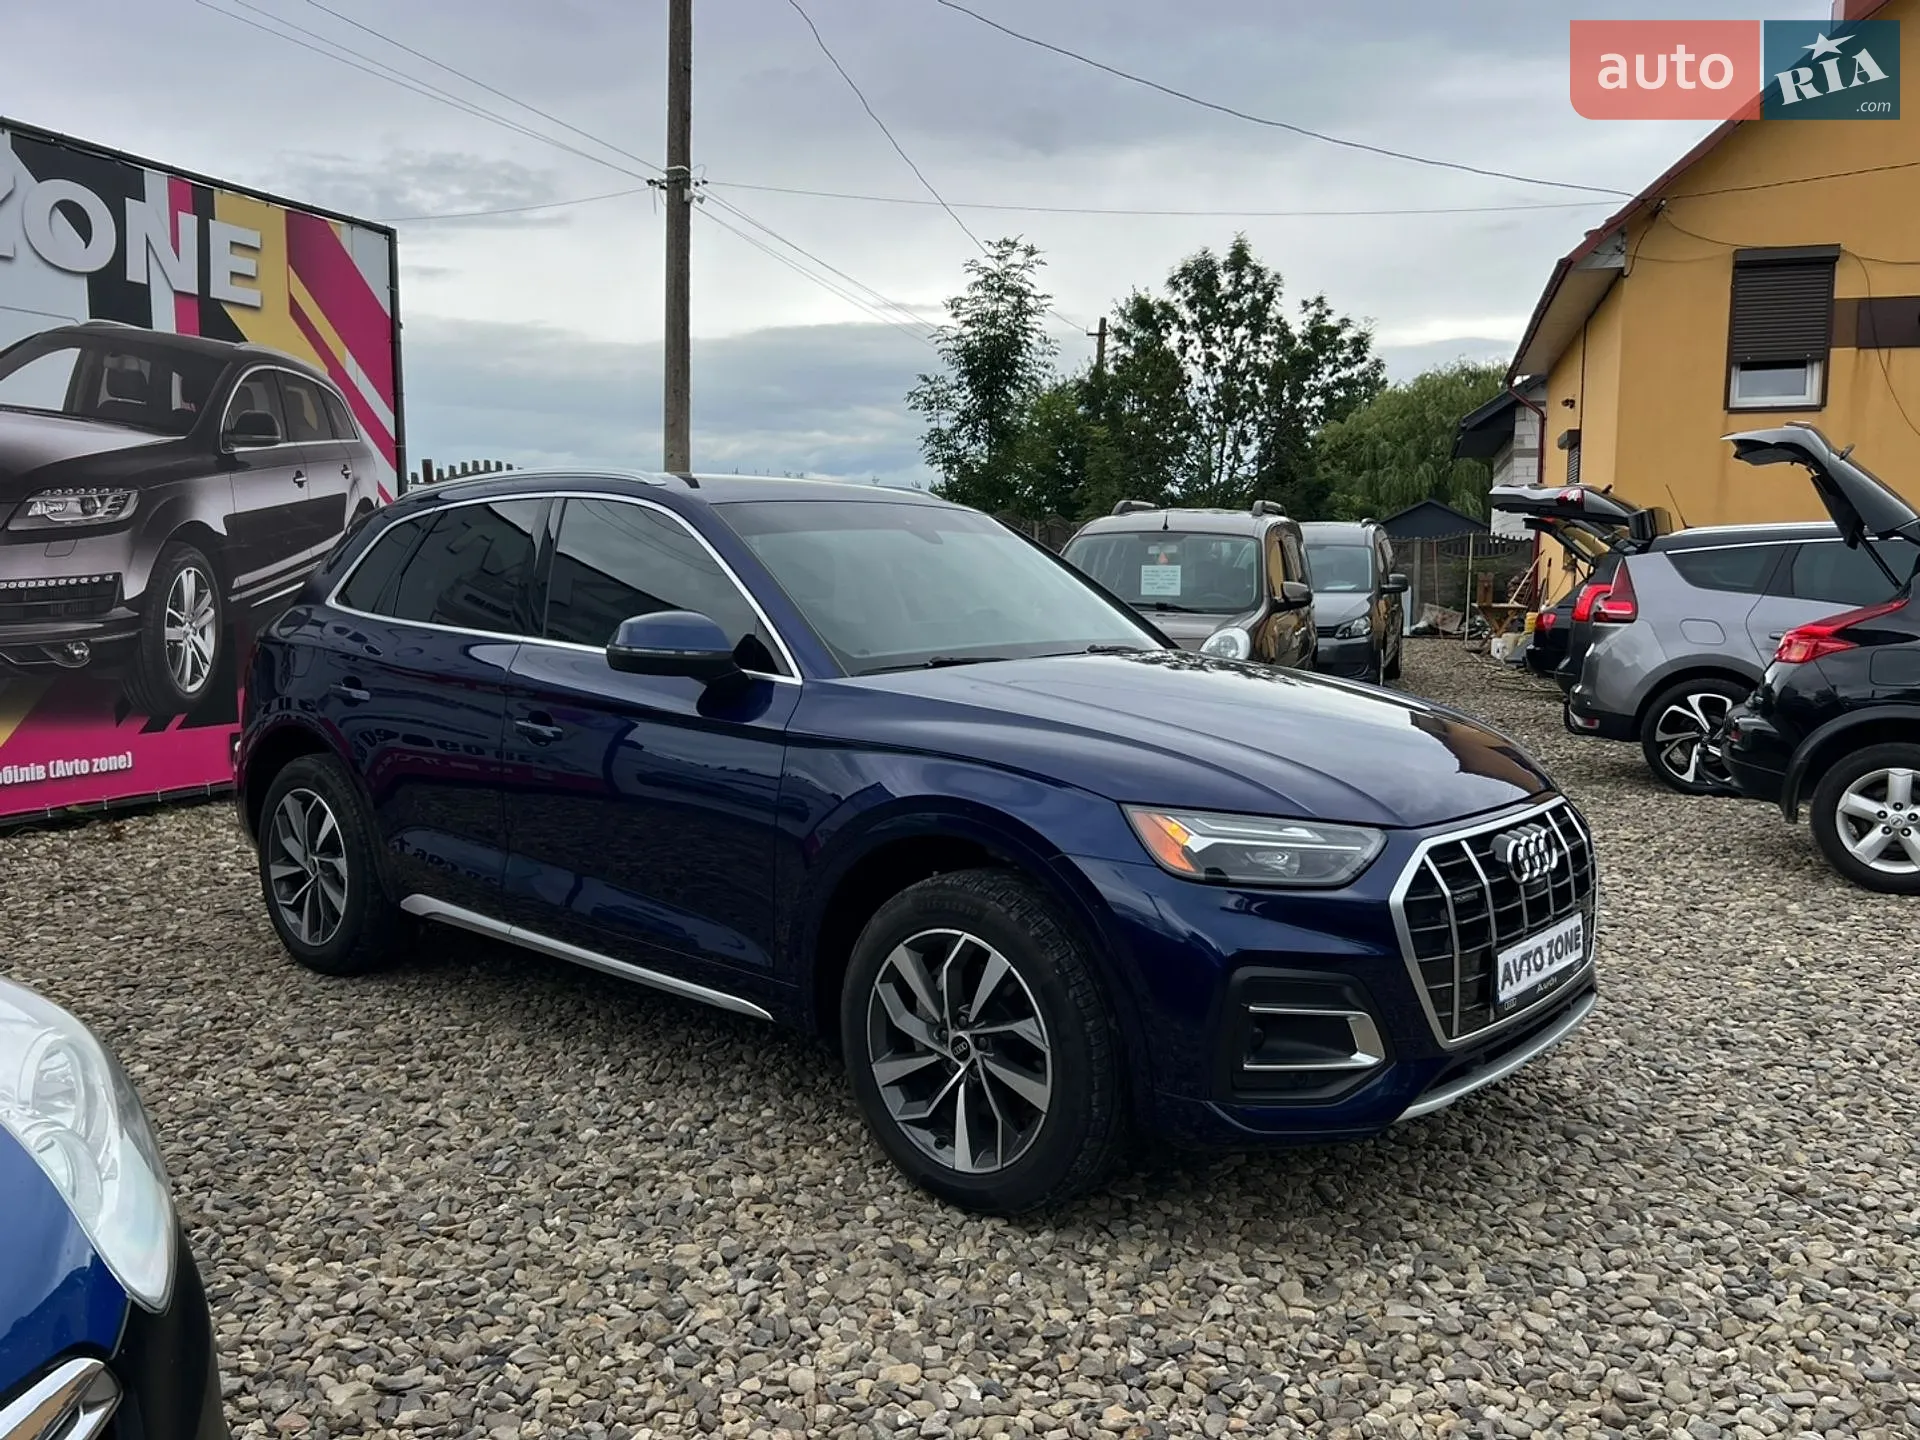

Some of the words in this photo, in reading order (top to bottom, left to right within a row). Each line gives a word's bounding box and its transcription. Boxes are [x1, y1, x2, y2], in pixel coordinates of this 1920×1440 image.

[0, 166, 262, 307] ONE
[0, 763, 46, 784] білів
[49, 759, 90, 778] (Avto
[92, 751, 132, 773] zone)
[1501, 946, 1544, 991] AVTO
[1546, 925, 1581, 965] ZONE
